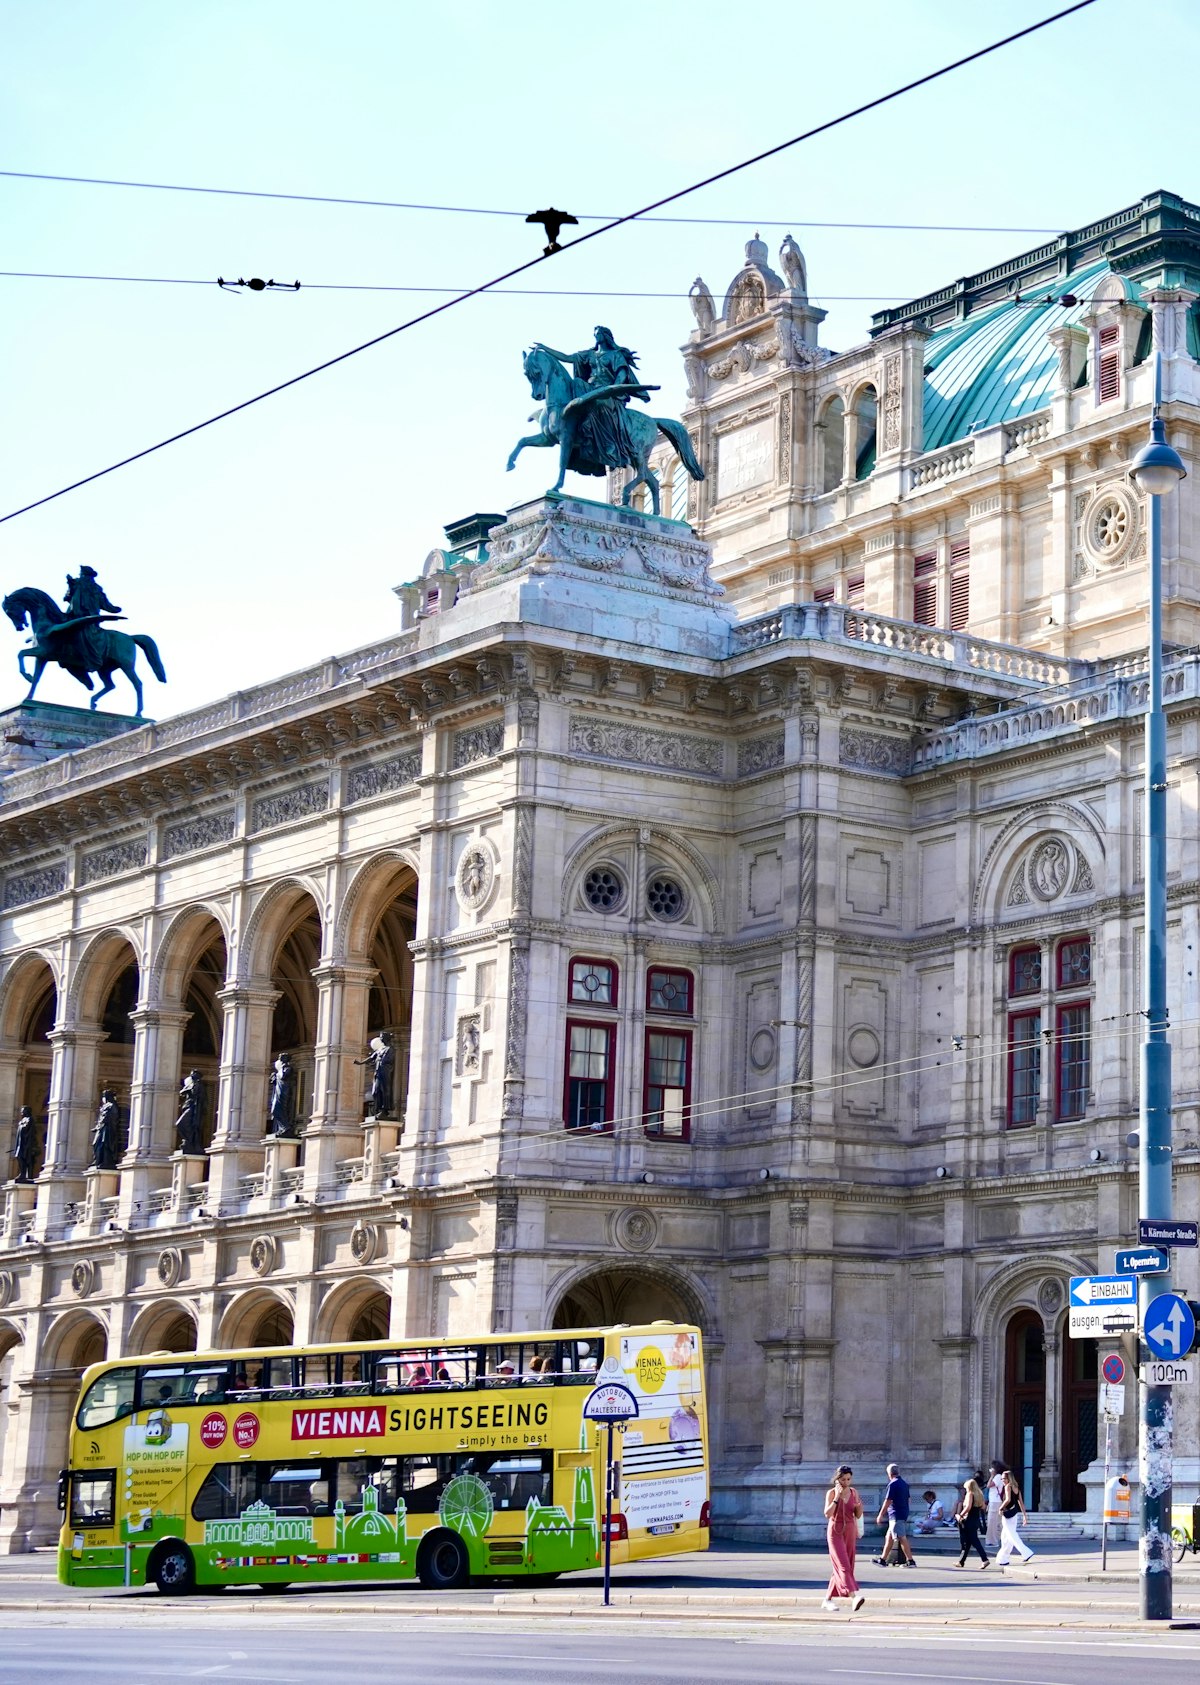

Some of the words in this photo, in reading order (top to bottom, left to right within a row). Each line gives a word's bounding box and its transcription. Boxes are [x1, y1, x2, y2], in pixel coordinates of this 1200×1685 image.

[1148, 1228, 1176, 1239] Kärntner
[1176, 1230, 1196, 1240] Straße
[1130, 1256, 1160, 1269] Opernring
[1091, 1284, 1129, 1298] EINBAHN
[1072, 1316, 1102, 1330] ausgen.
[635, 1358, 662, 1367] VIENNA
[640, 1367, 666, 1383] PASS
[597, 1389, 627, 1400] AUTOBUS
[296, 1410, 381, 1436] VIENNA
[389, 1402, 548, 1431] SIGHTSEEING
[204, 1421, 225, 1431] -10%
[238, 1429, 254, 1440] No.1
[460, 1435, 496, 1447] simply
[501, 1434, 518, 1444] the
[523, 1433, 548, 1444] best
[154, 1452, 169, 1460] HOP
[171, 1451, 184, 1459] OFF
[647, 1514, 684, 1524] VIENNAPASS.COM
